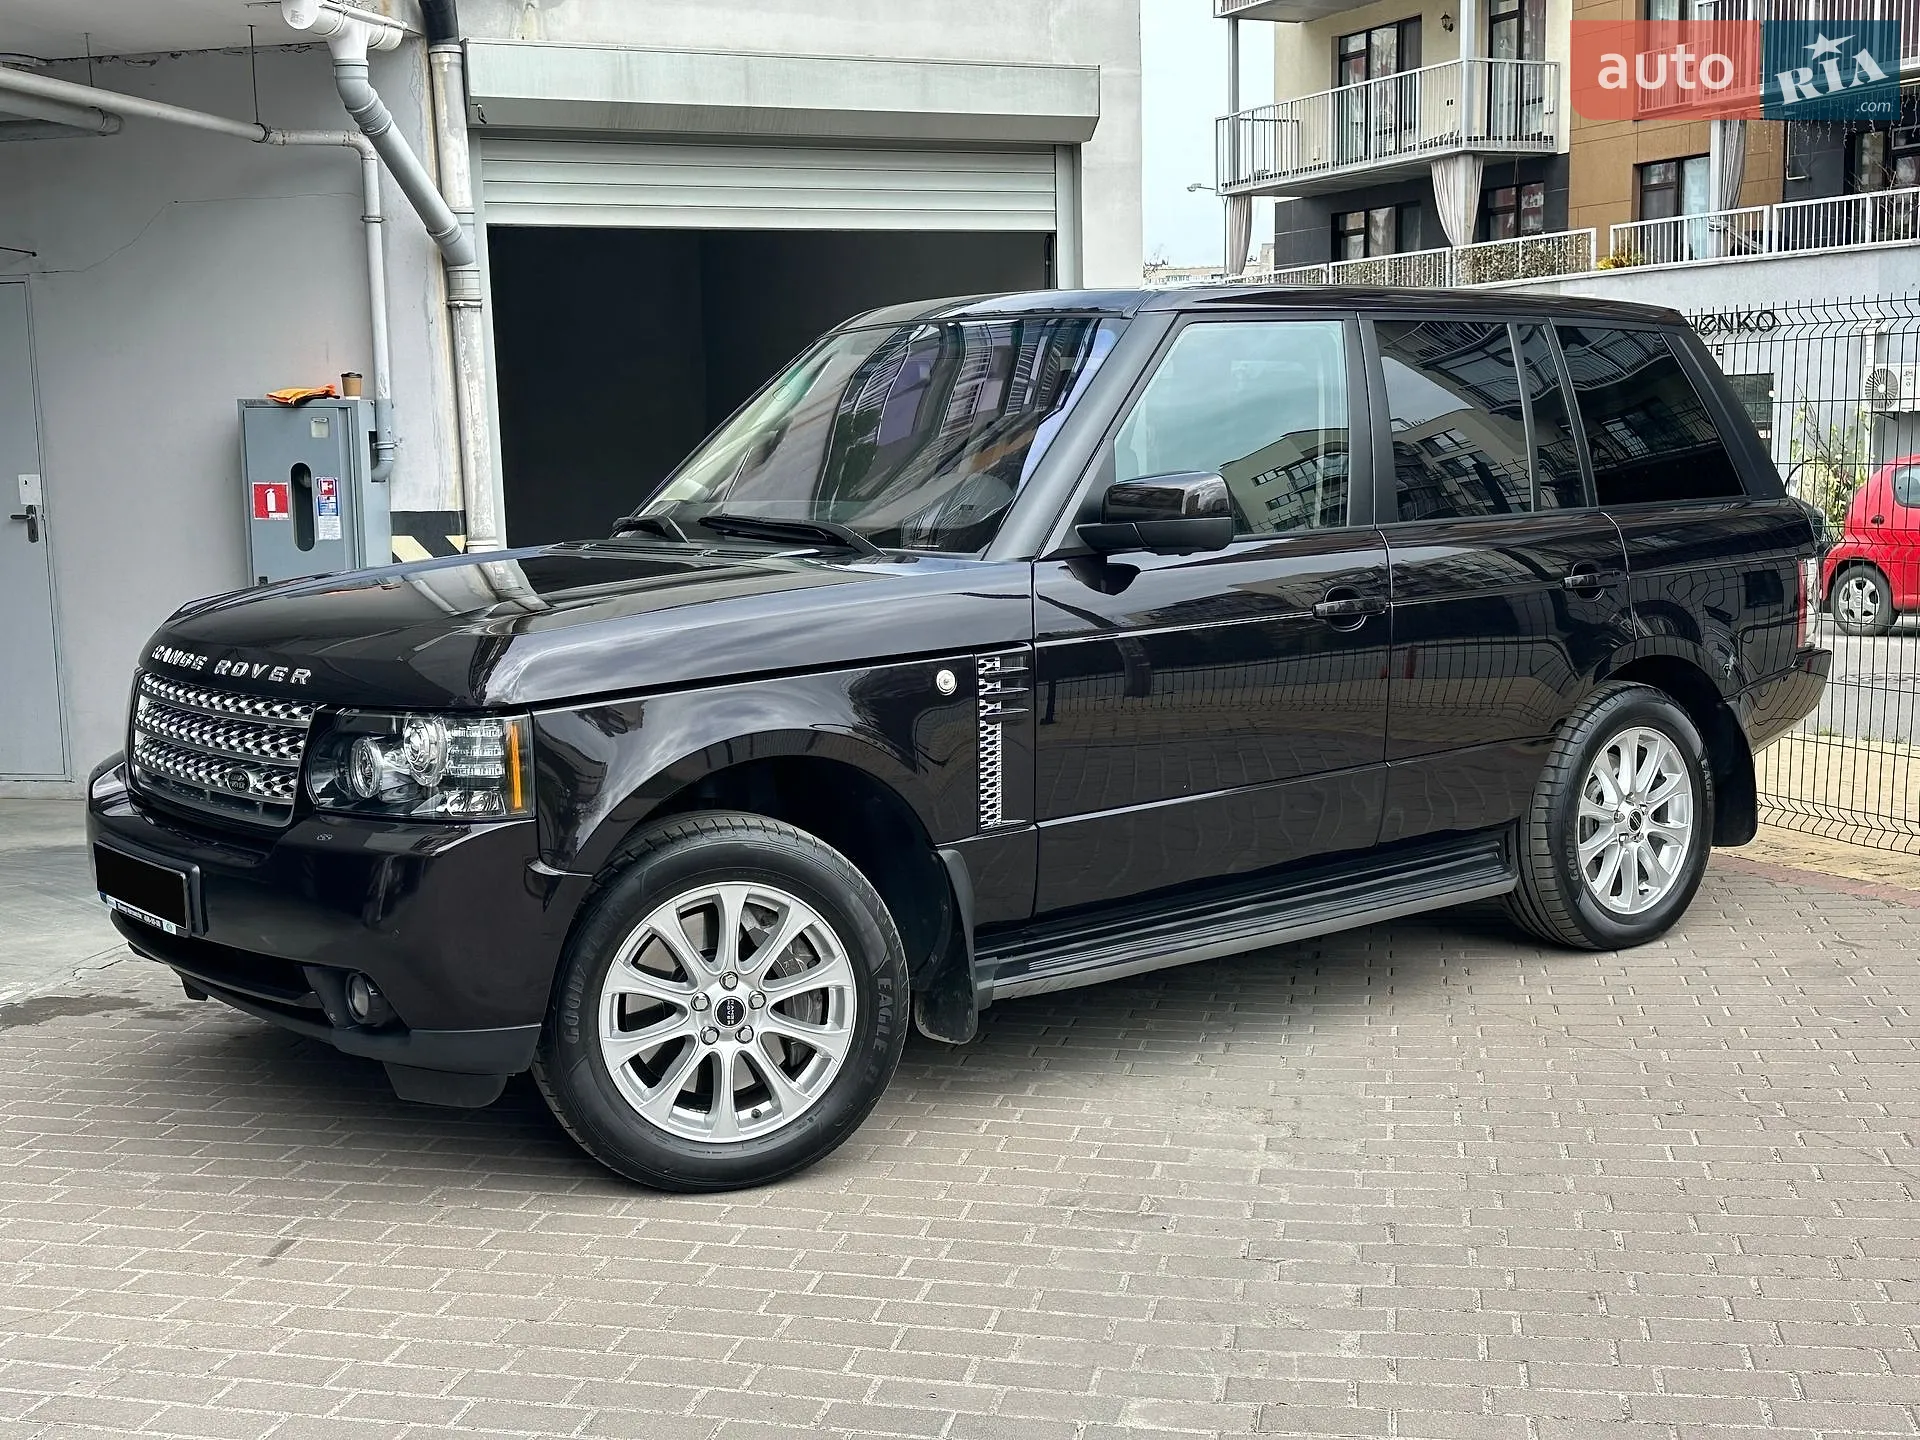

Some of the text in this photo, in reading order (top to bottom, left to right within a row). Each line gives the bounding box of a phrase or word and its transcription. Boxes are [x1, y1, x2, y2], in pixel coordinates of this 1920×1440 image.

[151, 644, 312, 685] RANGE ROVER
[873, 978, 893, 1053] EAGLE
